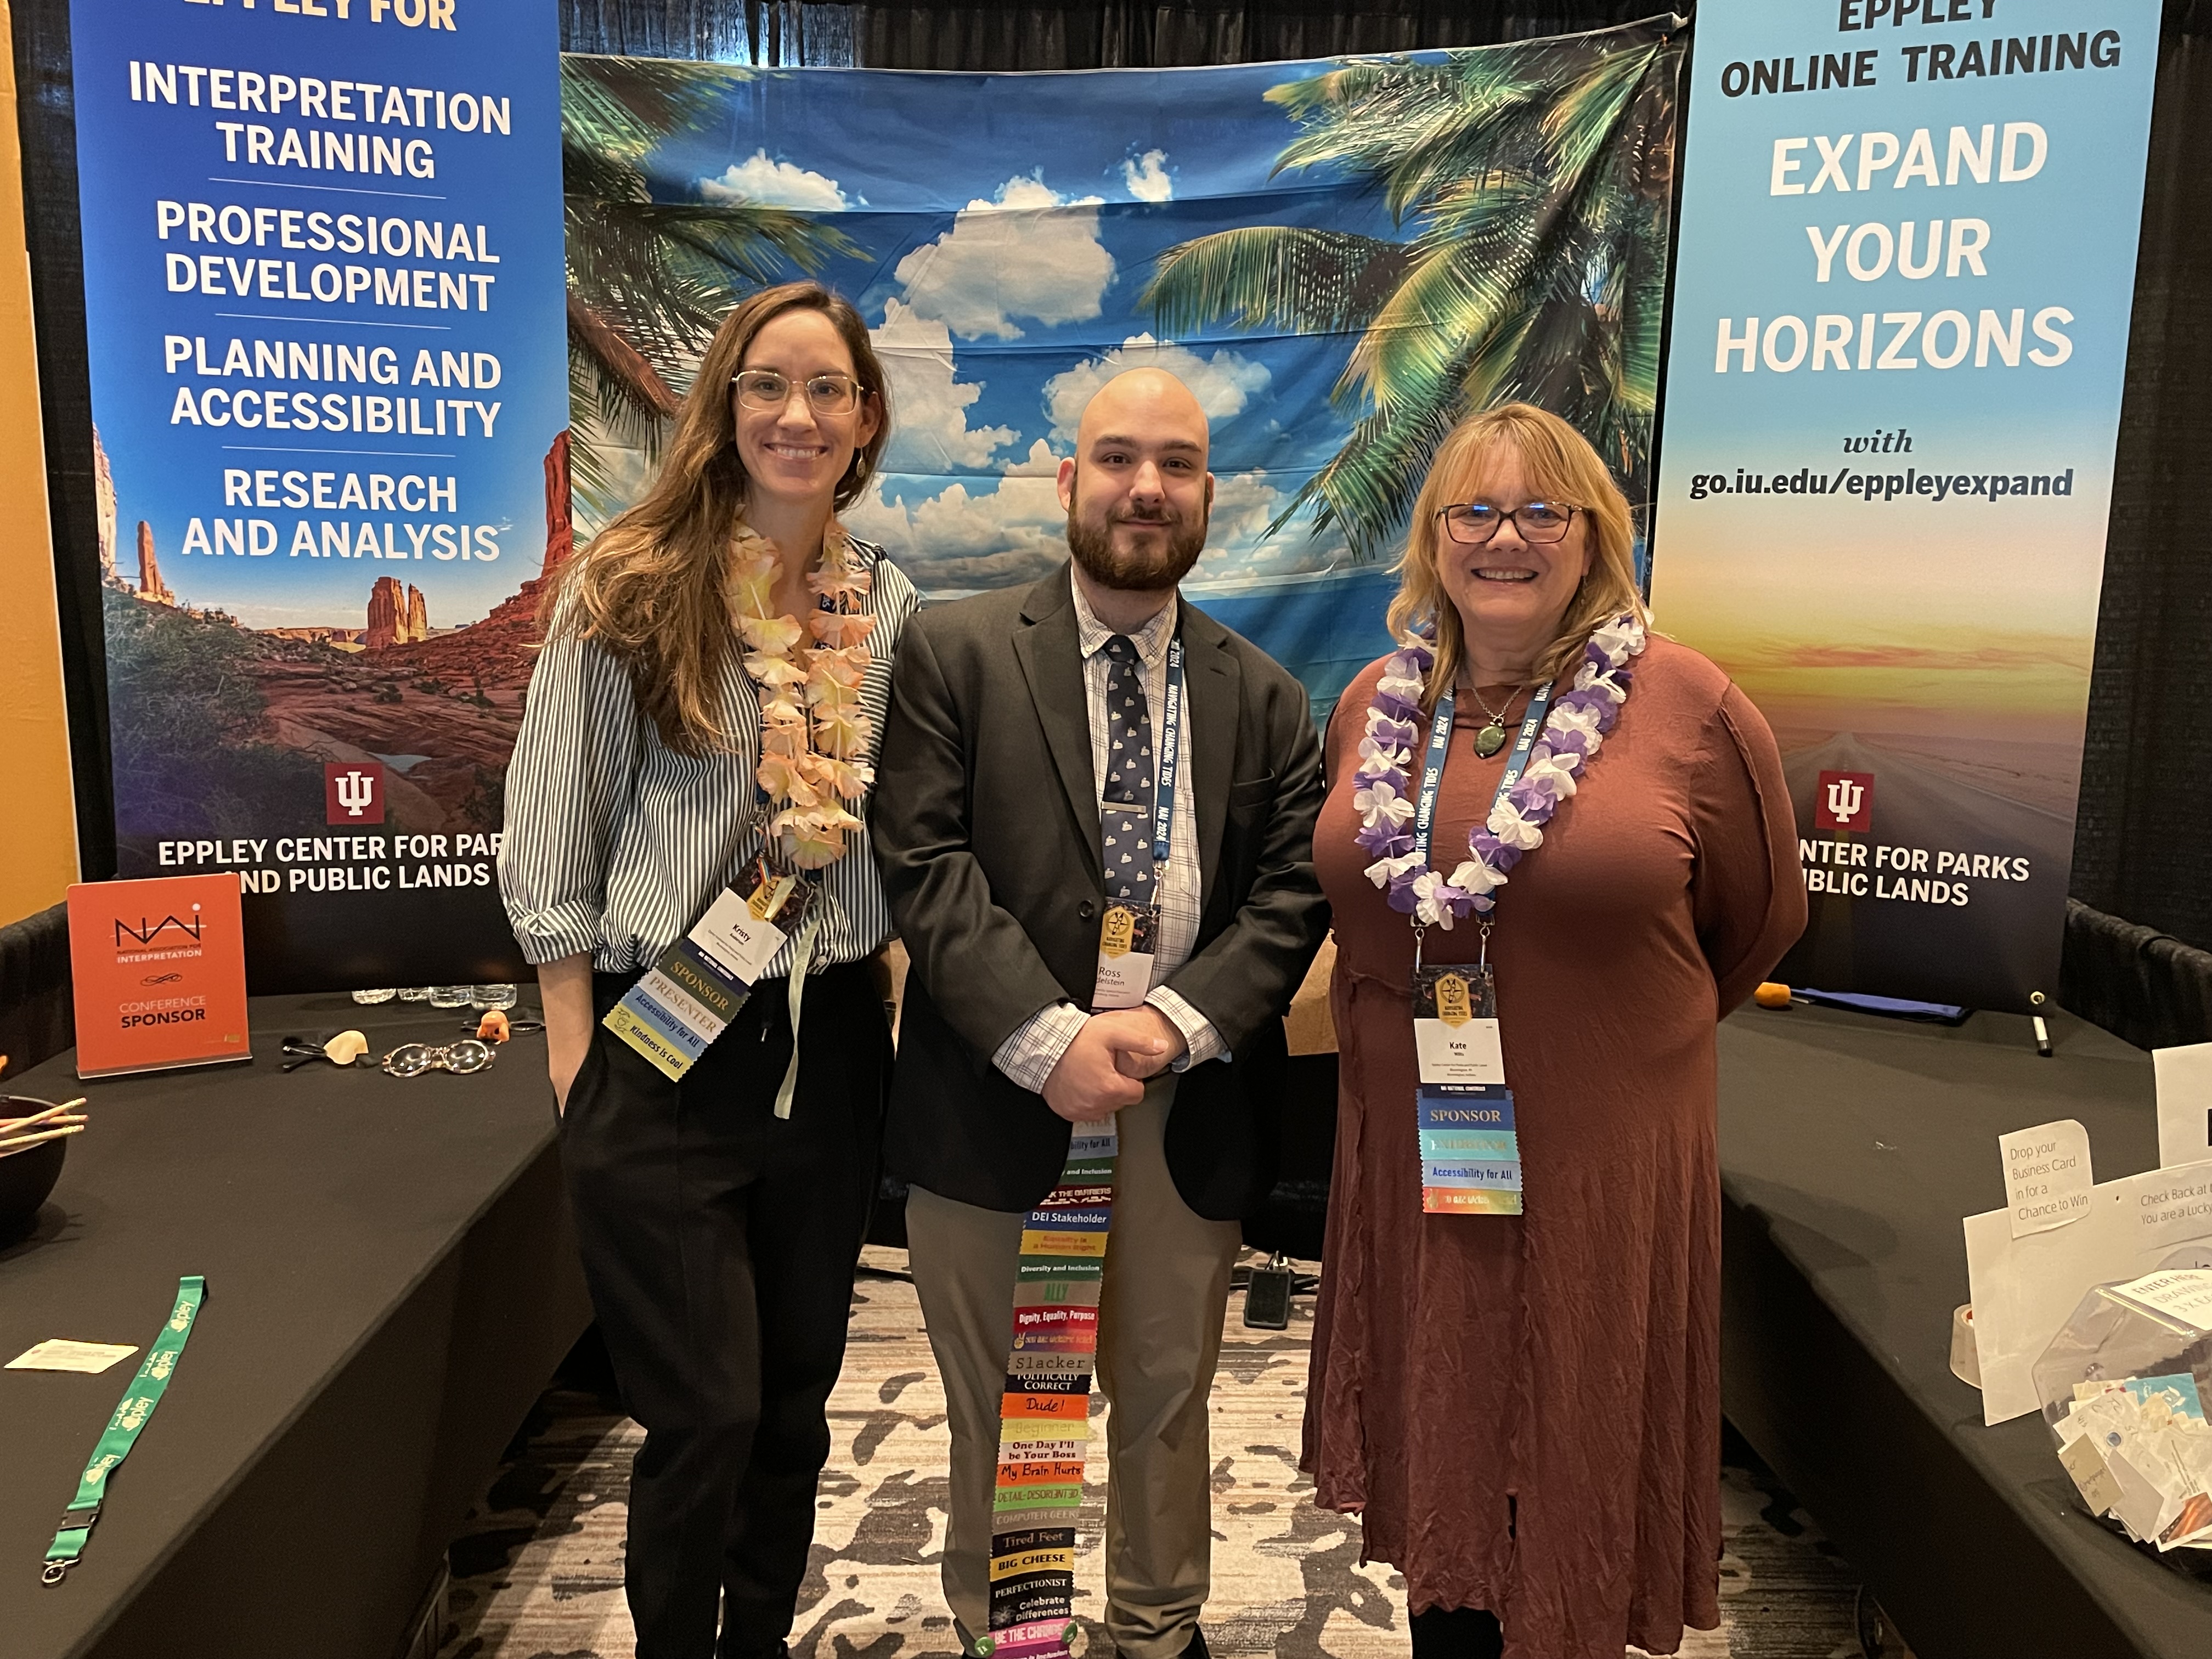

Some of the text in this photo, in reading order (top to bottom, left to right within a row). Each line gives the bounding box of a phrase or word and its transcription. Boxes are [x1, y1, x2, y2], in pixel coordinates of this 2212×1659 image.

[1721, 30, 2121, 98] ONLINE TRAINING
[129, 61, 511, 136] INTERPRETATION
[216, 122, 435, 179] TRAINING
[1770, 122, 2049, 196] EXPAND
[156, 200, 500, 263] PROFESSIONAL
[1805, 218, 1991, 283] YOUR
[166, 253, 495, 312] DEVELOPMENT
[1715, 307, 2075, 374] HORIZONS
[165, 335, 502, 389] PLANNING AND
[171, 387, 502, 437] ACCESSIBILITY
[1843, 428, 1914, 454] with
[224, 469, 457, 512] RESEARCH
[1690, 468, 2074, 501] go.iu.edu/eppleyexpand
[182, 518, 500, 561] AND ANALYSIS
[1170, 650, 1180, 668] 2024
[1161, 684, 1178, 787] NAVIGATING CHANGING TIDES
[1432, 735, 1445, 749] NAI
[1516, 719, 1538, 751] NAI 2024
[1424, 768, 1438, 788] TIDES
[1500, 769, 1519, 789] TIDES
[1417, 790, 1434, 830] CHANGING
[1156, 806, 1169, 840] NAI 2024
[159, 833, 504, 866] EPPLEY CENTER FOR PAR
[1799, 839, 2030, 882] NTER FOR PARKS
[224, 863, 490, 894] ND PUBLIC LANDS
[1803, 869, 1970, 906] BLIC LANDS
[732, 923, 751, 942] Kristy
[117, 950, 202, 963] INTERPRETATION
[1097, 977, 1125, 986] delstein
[1099, 967, 1121, 978] Ross
[670, 961, 729, 1011] SPONSOR
[119, 995, 206, 1014] CONFERENCE
[649, 977, 716, 1032] PRESENTER
[121, 1008, 206, 1028] SPONSOR
[635, 994, 700, 1047] Accessibility for All
[630, 1025, 661, 1052] Kindness
[667, 1054, 684, 1069] Cool
[1430, 1109, 1502, 1122] SPONSOR
[1090, 1140, 1099, 1148] for
[1102, 1138, 1110, 1147] All
[2010, 1142, 2056, 1160] Drop your
[1432, 1167, 1513, 1181] Accessibility for All
[2012, 1155, 2076, 1180] Business Card
[2016, 1184, 2048, 1200] in for a
[2141, 1189, 2169, 1206] Check
[2172, 1186, 2194, 1200] Back
[2018, 1194, 2088, 1220] Chance to Win
[2141, 1213, 2158, 1225] You
[2160, 1209, 2176, 1222] are
[2177, 1208, 2185, 1218] a
[1032, 1212, 1107, 1223] DEI Stakeholder
[2132, 1277, 2175, 1295] ENTER
[1070, 1310, 1095, 1321] Purpose
[1016, 1356, 1085, 1369] Slacker
[1024, 1381, 1073, 1391] CORRECT
[1036, 1441, 1056, 1449] Day
[1001, 1463, 1081, 1481] My Brain Hurts
[996, 1511, 1047, 1525] COMPUTER
[1003, 1532, 1064, 1548] Tired Feet
[998, 1554, 1065, 1571] BIG CHEESE
[995, 1578, 1067, 1598] PERFECTIONIST
[1019, 1596, 1065, 1610] Celebrate
[1016, 1608, 1069, 1622] Differences
[995, 1630, 1007, 1645] BE
[1009, 1627, 1026, 1643] THE
